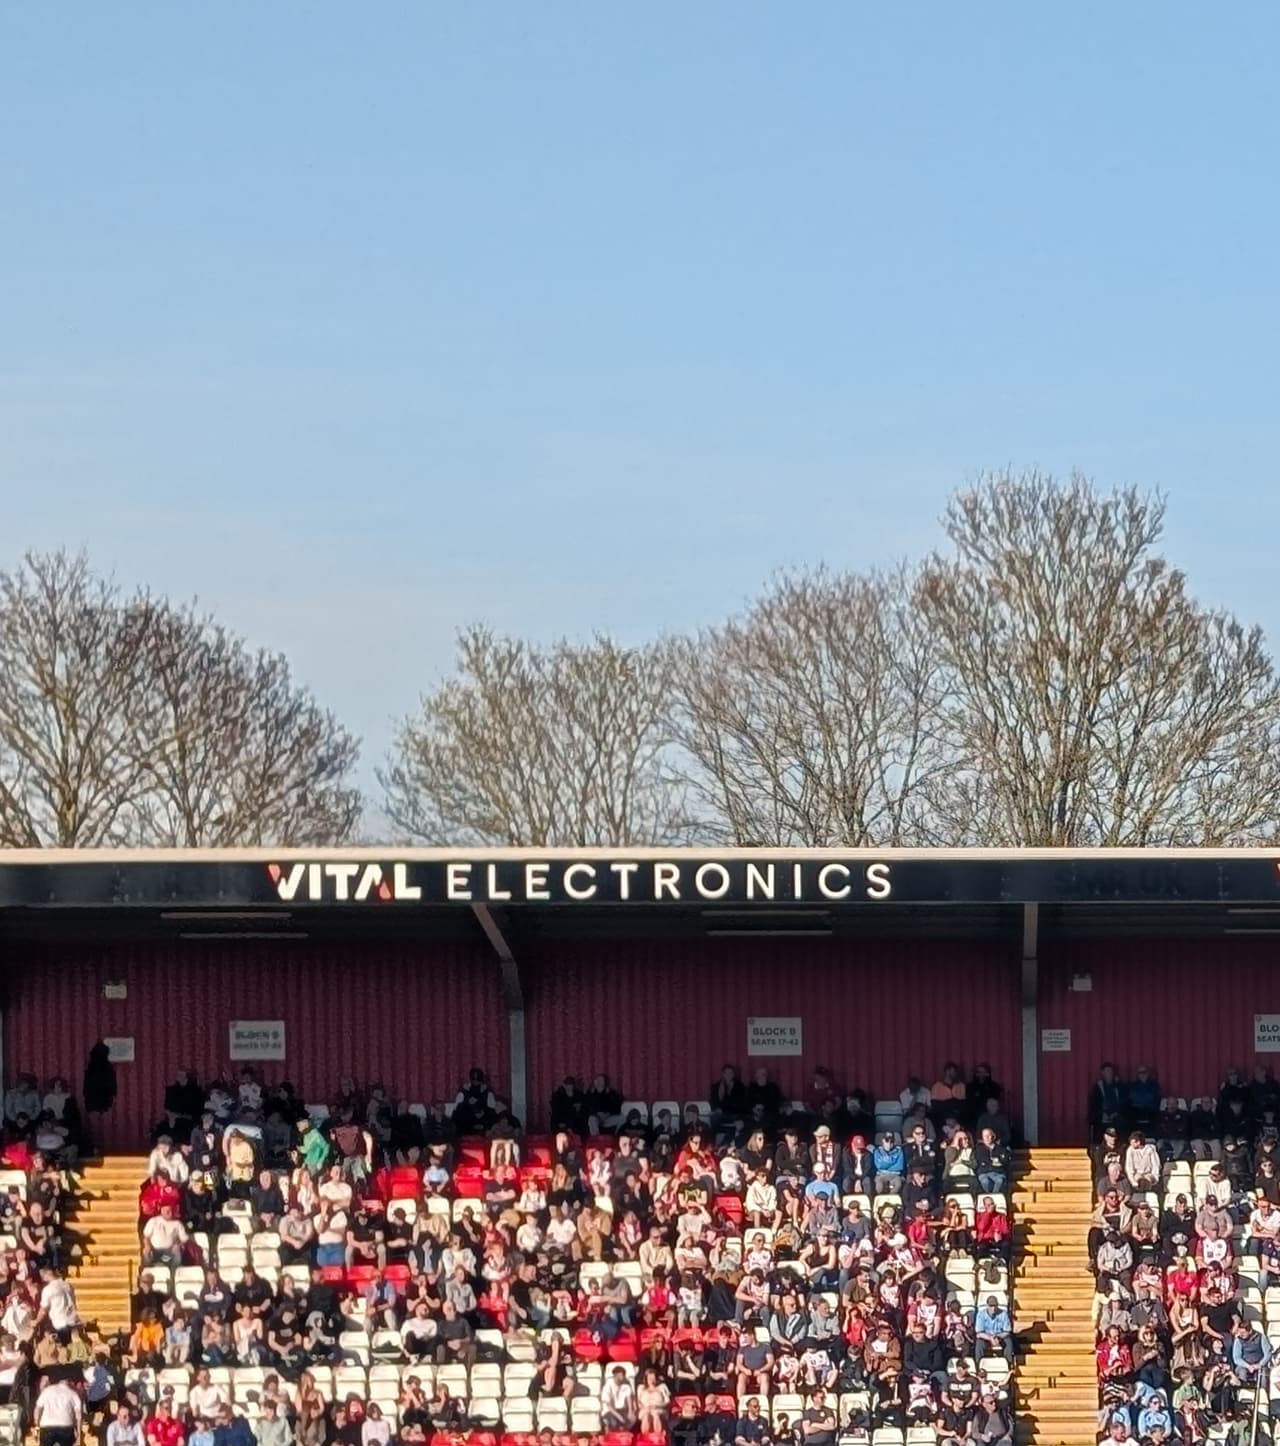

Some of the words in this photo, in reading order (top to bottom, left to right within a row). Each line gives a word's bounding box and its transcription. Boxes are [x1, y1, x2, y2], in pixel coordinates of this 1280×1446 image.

[267, 863, 421, 900] VITAL
[446, 862, 893, 900] ELECTRONICS
[752, 1027, 787, 1036] BLOCK
[751, 1038, 777, 1046] SEATS
[1256, 1035, 1280, 1043] SEATS
